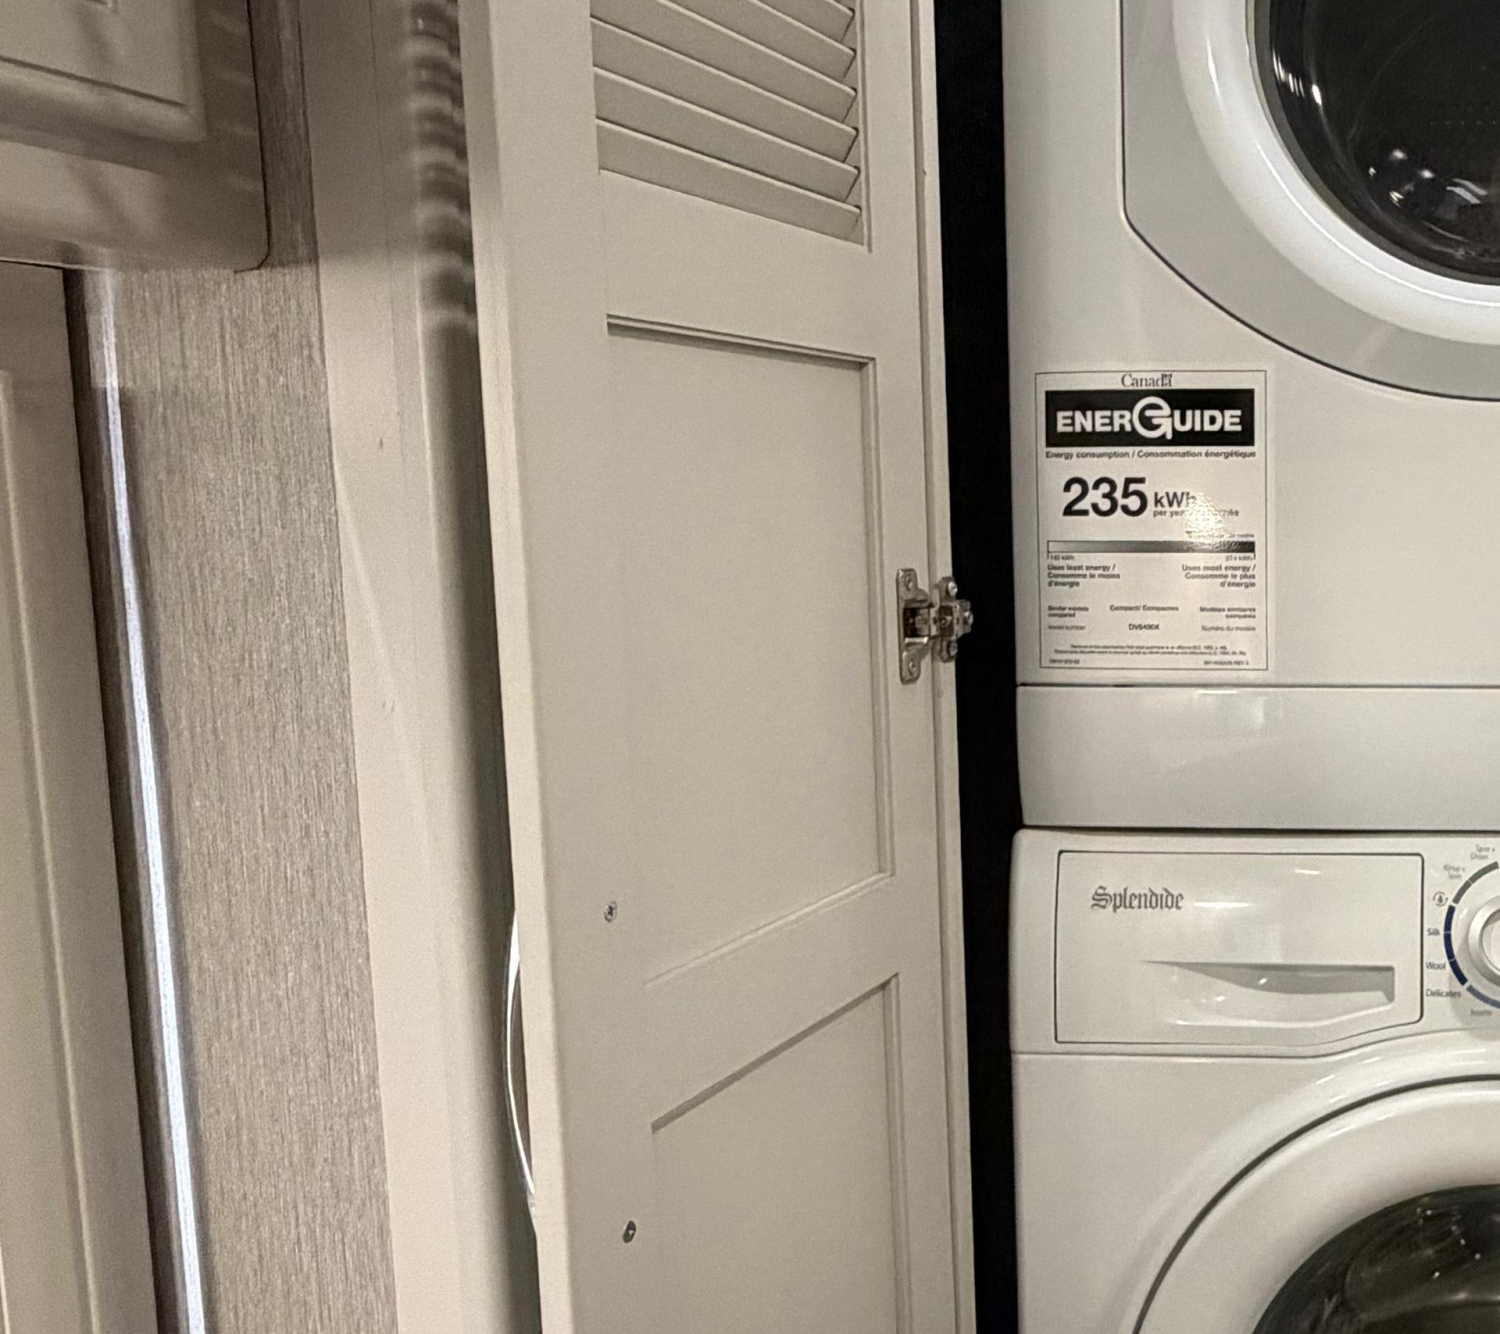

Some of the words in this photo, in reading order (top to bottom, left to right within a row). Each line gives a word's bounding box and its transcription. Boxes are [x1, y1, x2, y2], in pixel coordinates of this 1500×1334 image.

[1121, 373, 1173, 388] Canada
[1056, 396, 1242, 440] ENERGUIDE
[1045, 451, 1073, 460] Energy
[1076, 451, 1129, 459] consumption
[1137, 450, 1202, 458] Consommation
[1204, 450, 1256, 459] énergétique
[1063, 476, 1148, 517] 235
[1091, 885, 1184, 913] Splendide
[1426, 962, 1446, 970] Wool
[1426, 988, 1461, 998] Delicates
